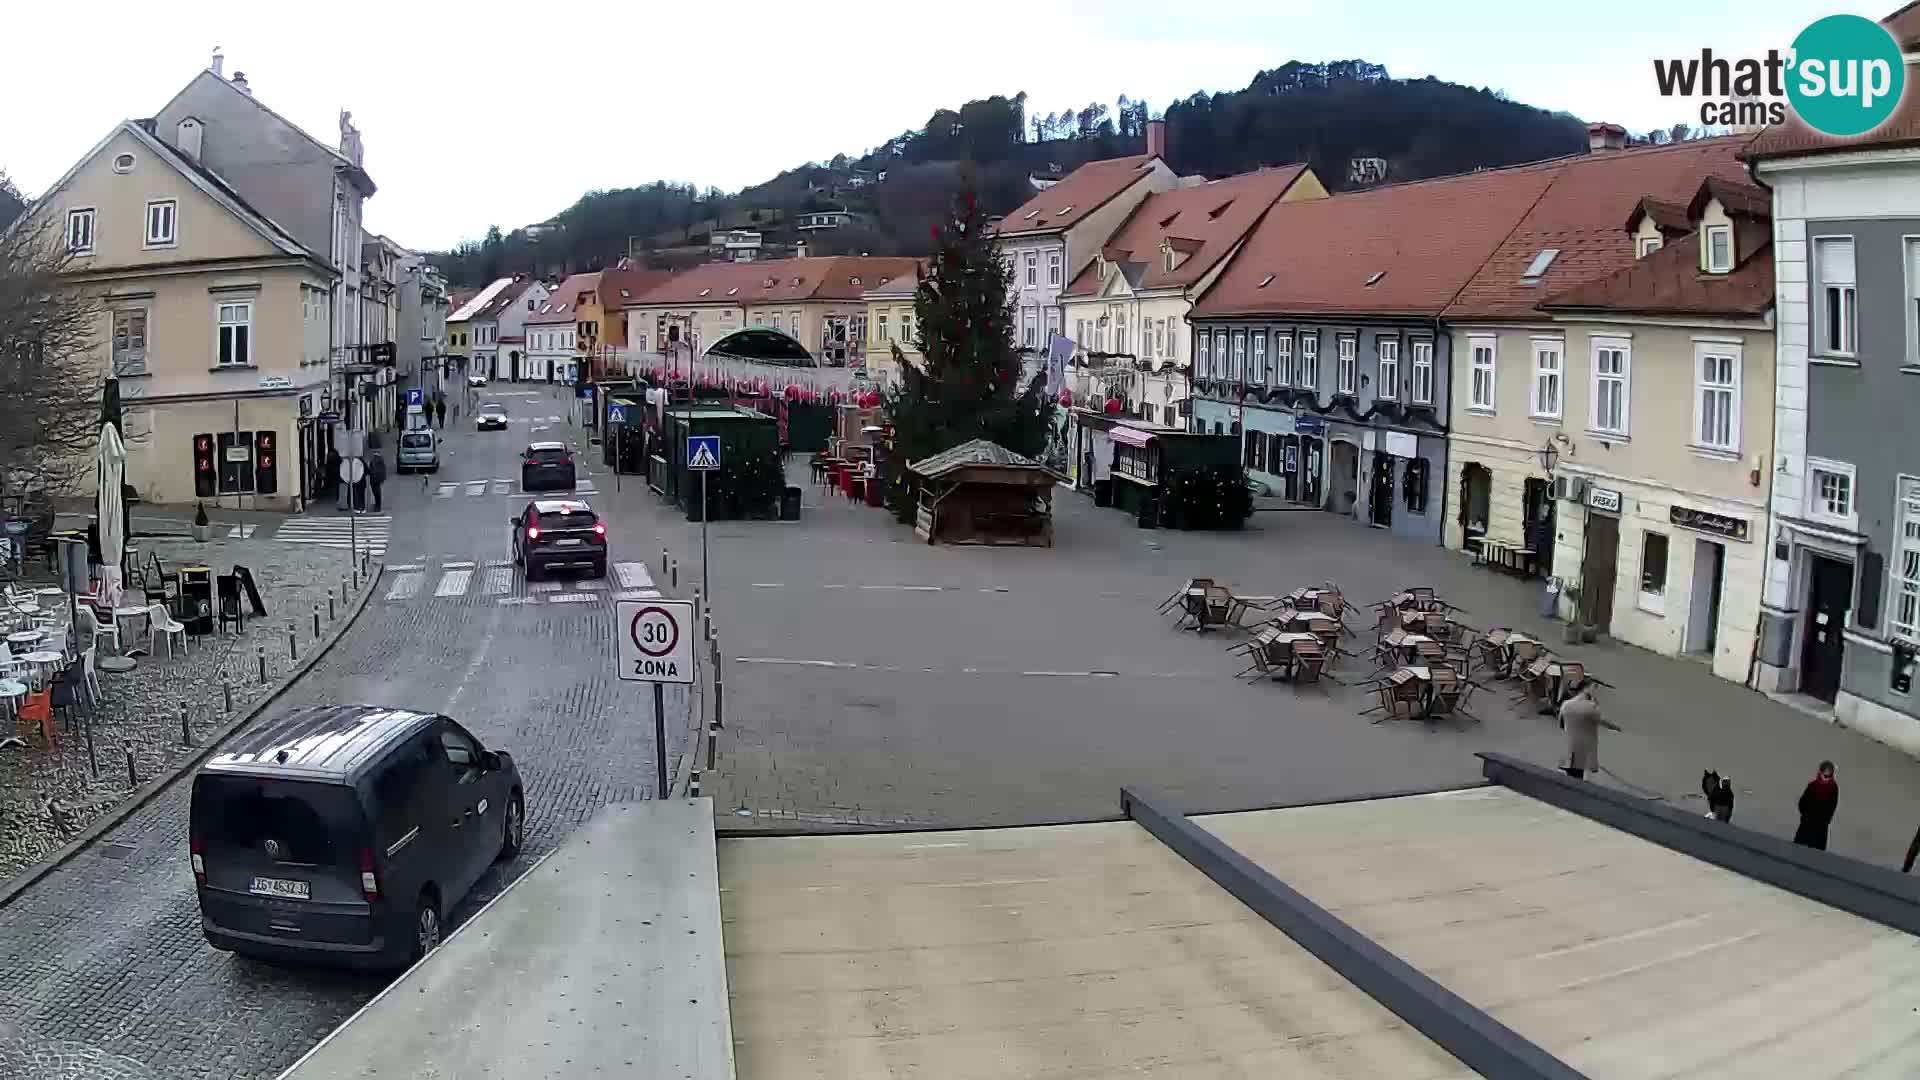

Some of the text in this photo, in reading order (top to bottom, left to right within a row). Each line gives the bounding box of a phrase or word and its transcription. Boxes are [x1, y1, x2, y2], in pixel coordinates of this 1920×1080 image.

[411, 391, 420, 403] P
[644, 622, 667, 643] 30
[633, 659, 678, 676] ZONA
